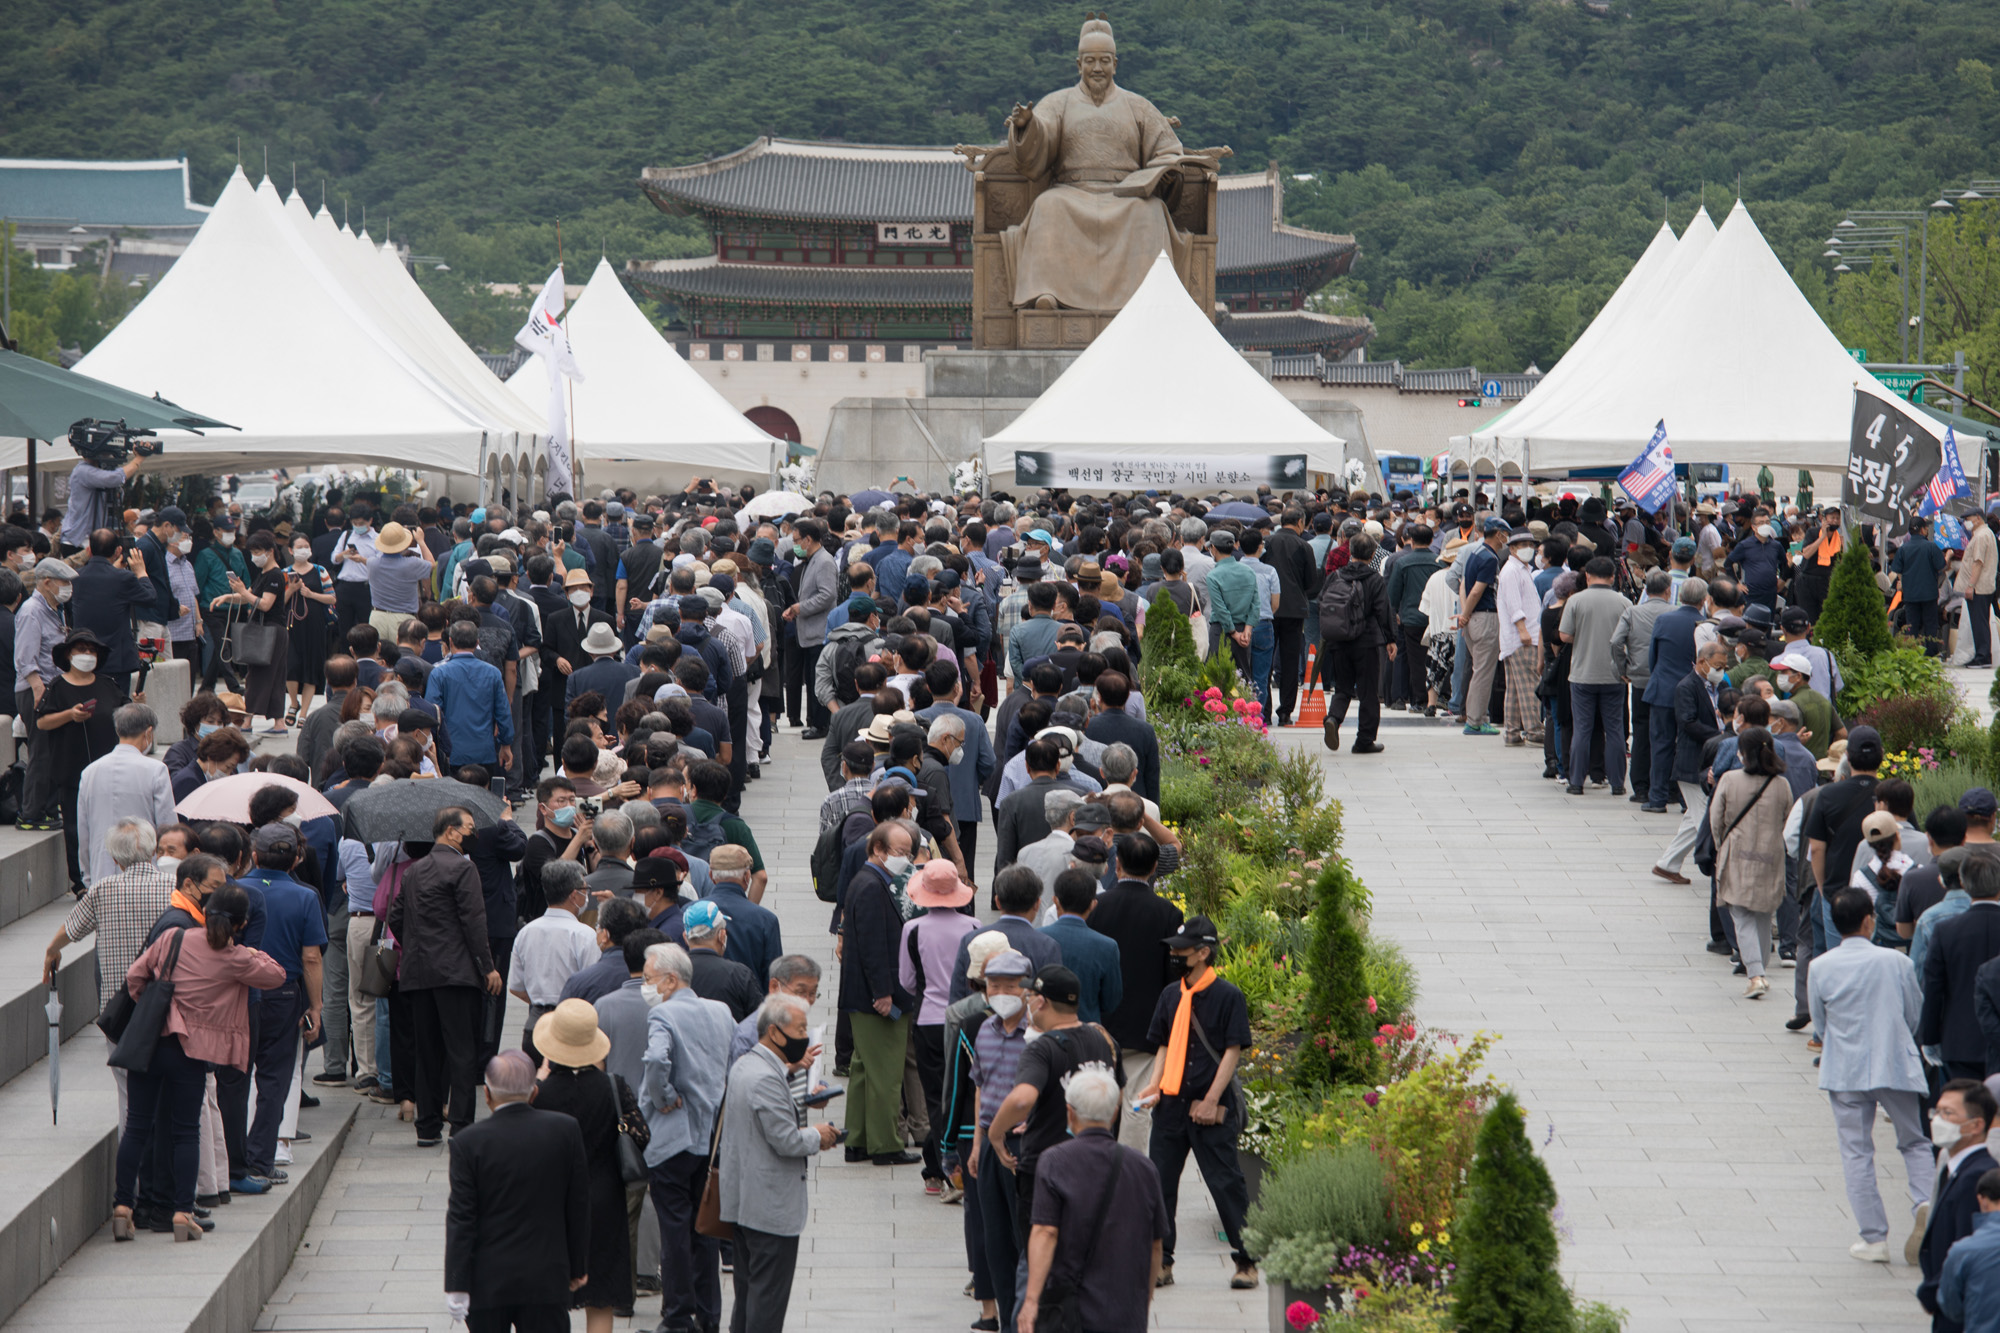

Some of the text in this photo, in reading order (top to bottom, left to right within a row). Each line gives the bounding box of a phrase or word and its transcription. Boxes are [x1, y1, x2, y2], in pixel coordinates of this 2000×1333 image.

[1068, 467, 1251, 484] 백선엽 장군 국민장 시민 분향소
